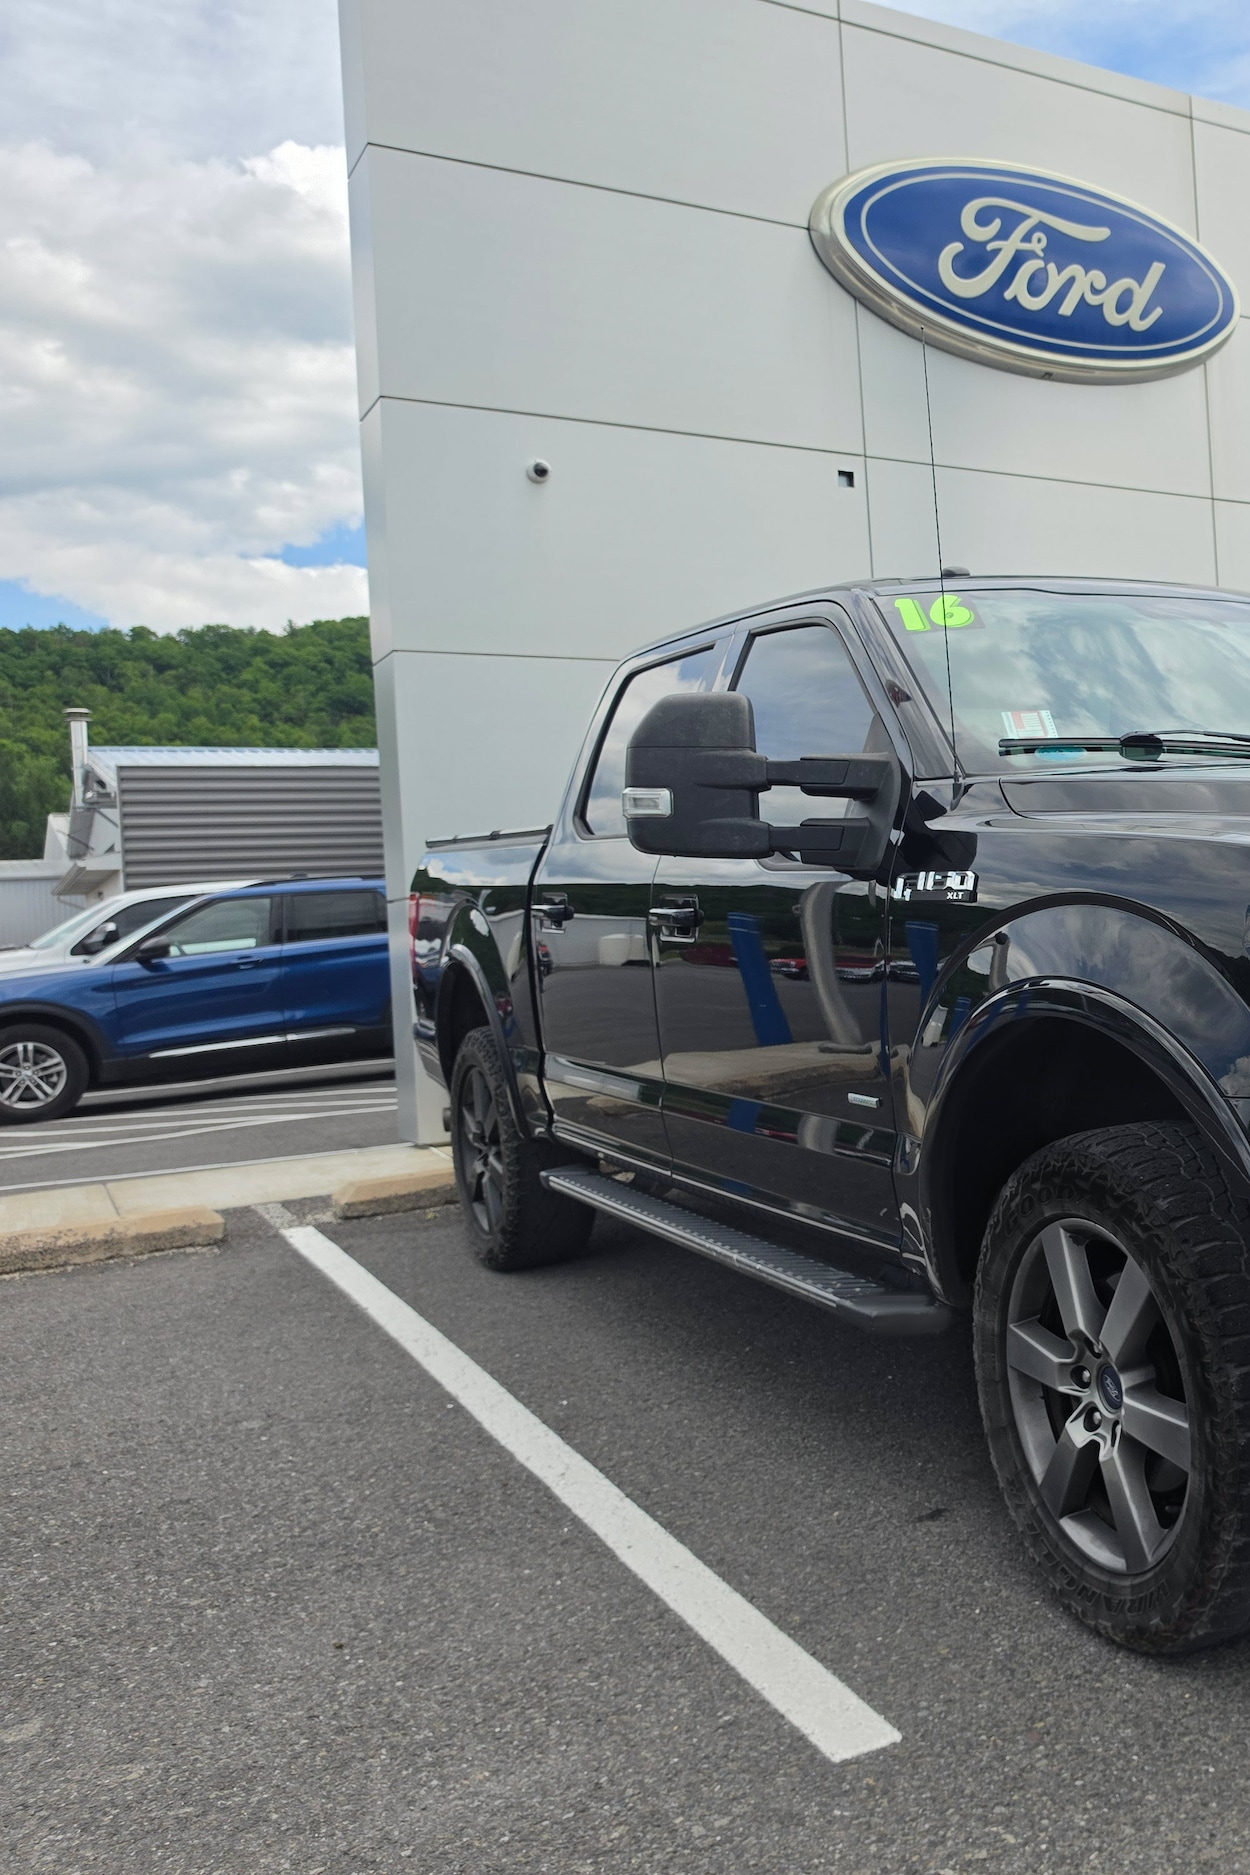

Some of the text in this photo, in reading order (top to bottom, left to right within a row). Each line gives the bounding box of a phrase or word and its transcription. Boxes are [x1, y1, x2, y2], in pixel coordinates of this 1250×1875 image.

[937, 196, 1167, 333] Ford
[894, 593, 975, 632] 16
[946, 891, 965, 900] XLT
